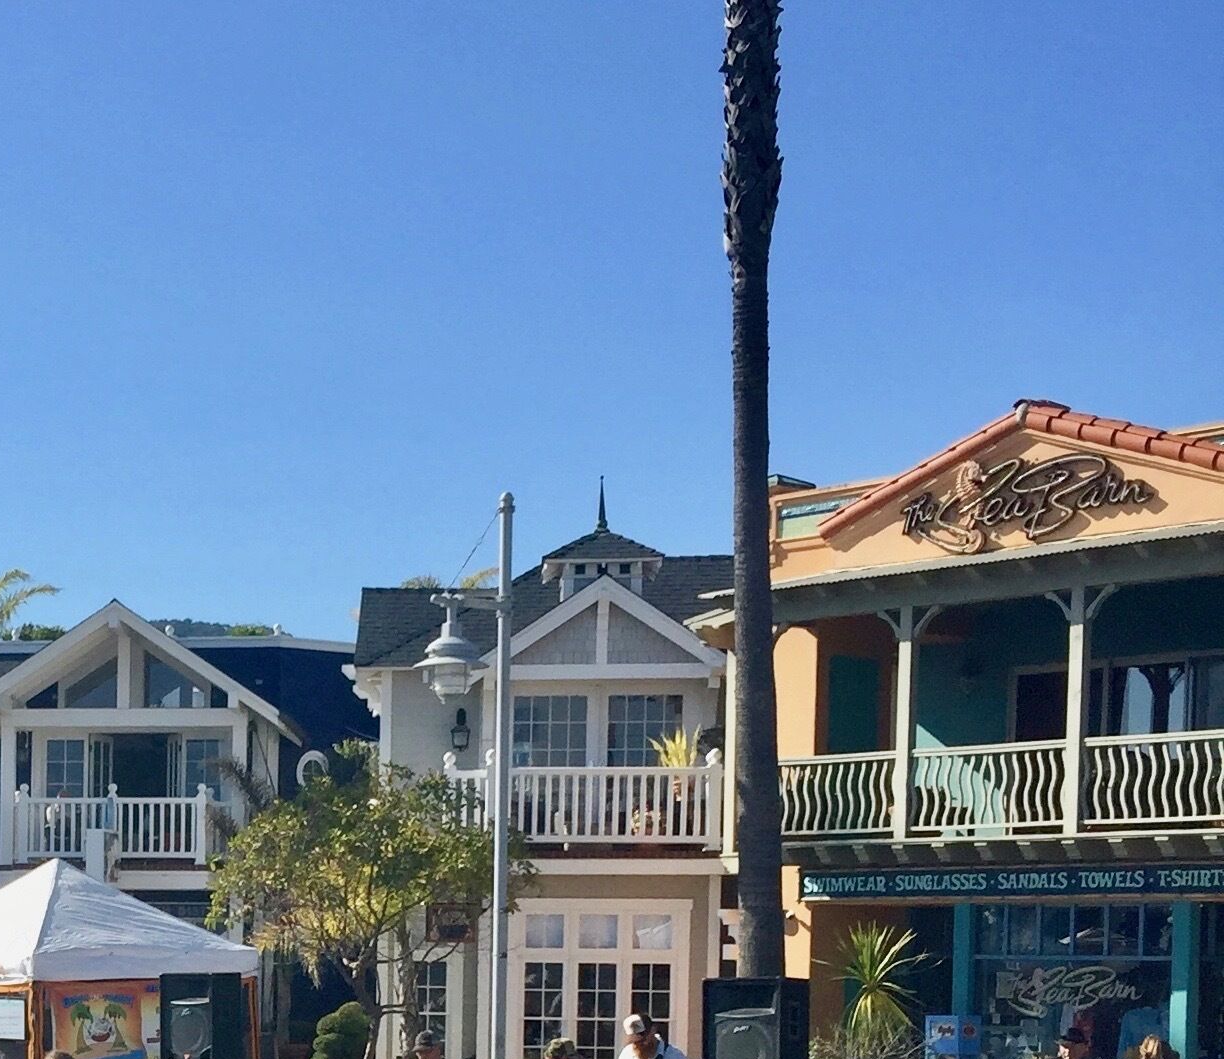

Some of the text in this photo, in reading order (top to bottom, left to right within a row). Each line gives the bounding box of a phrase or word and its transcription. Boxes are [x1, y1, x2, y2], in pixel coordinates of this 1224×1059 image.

[903, 454, 1148, 549] The Sea Barn
[804, 868, 1224, 893] SWIMWEAR SUNGLASSES SANDALS TOWELS T-SHIRT
[1062, 966, 1143, 1013] Barn
